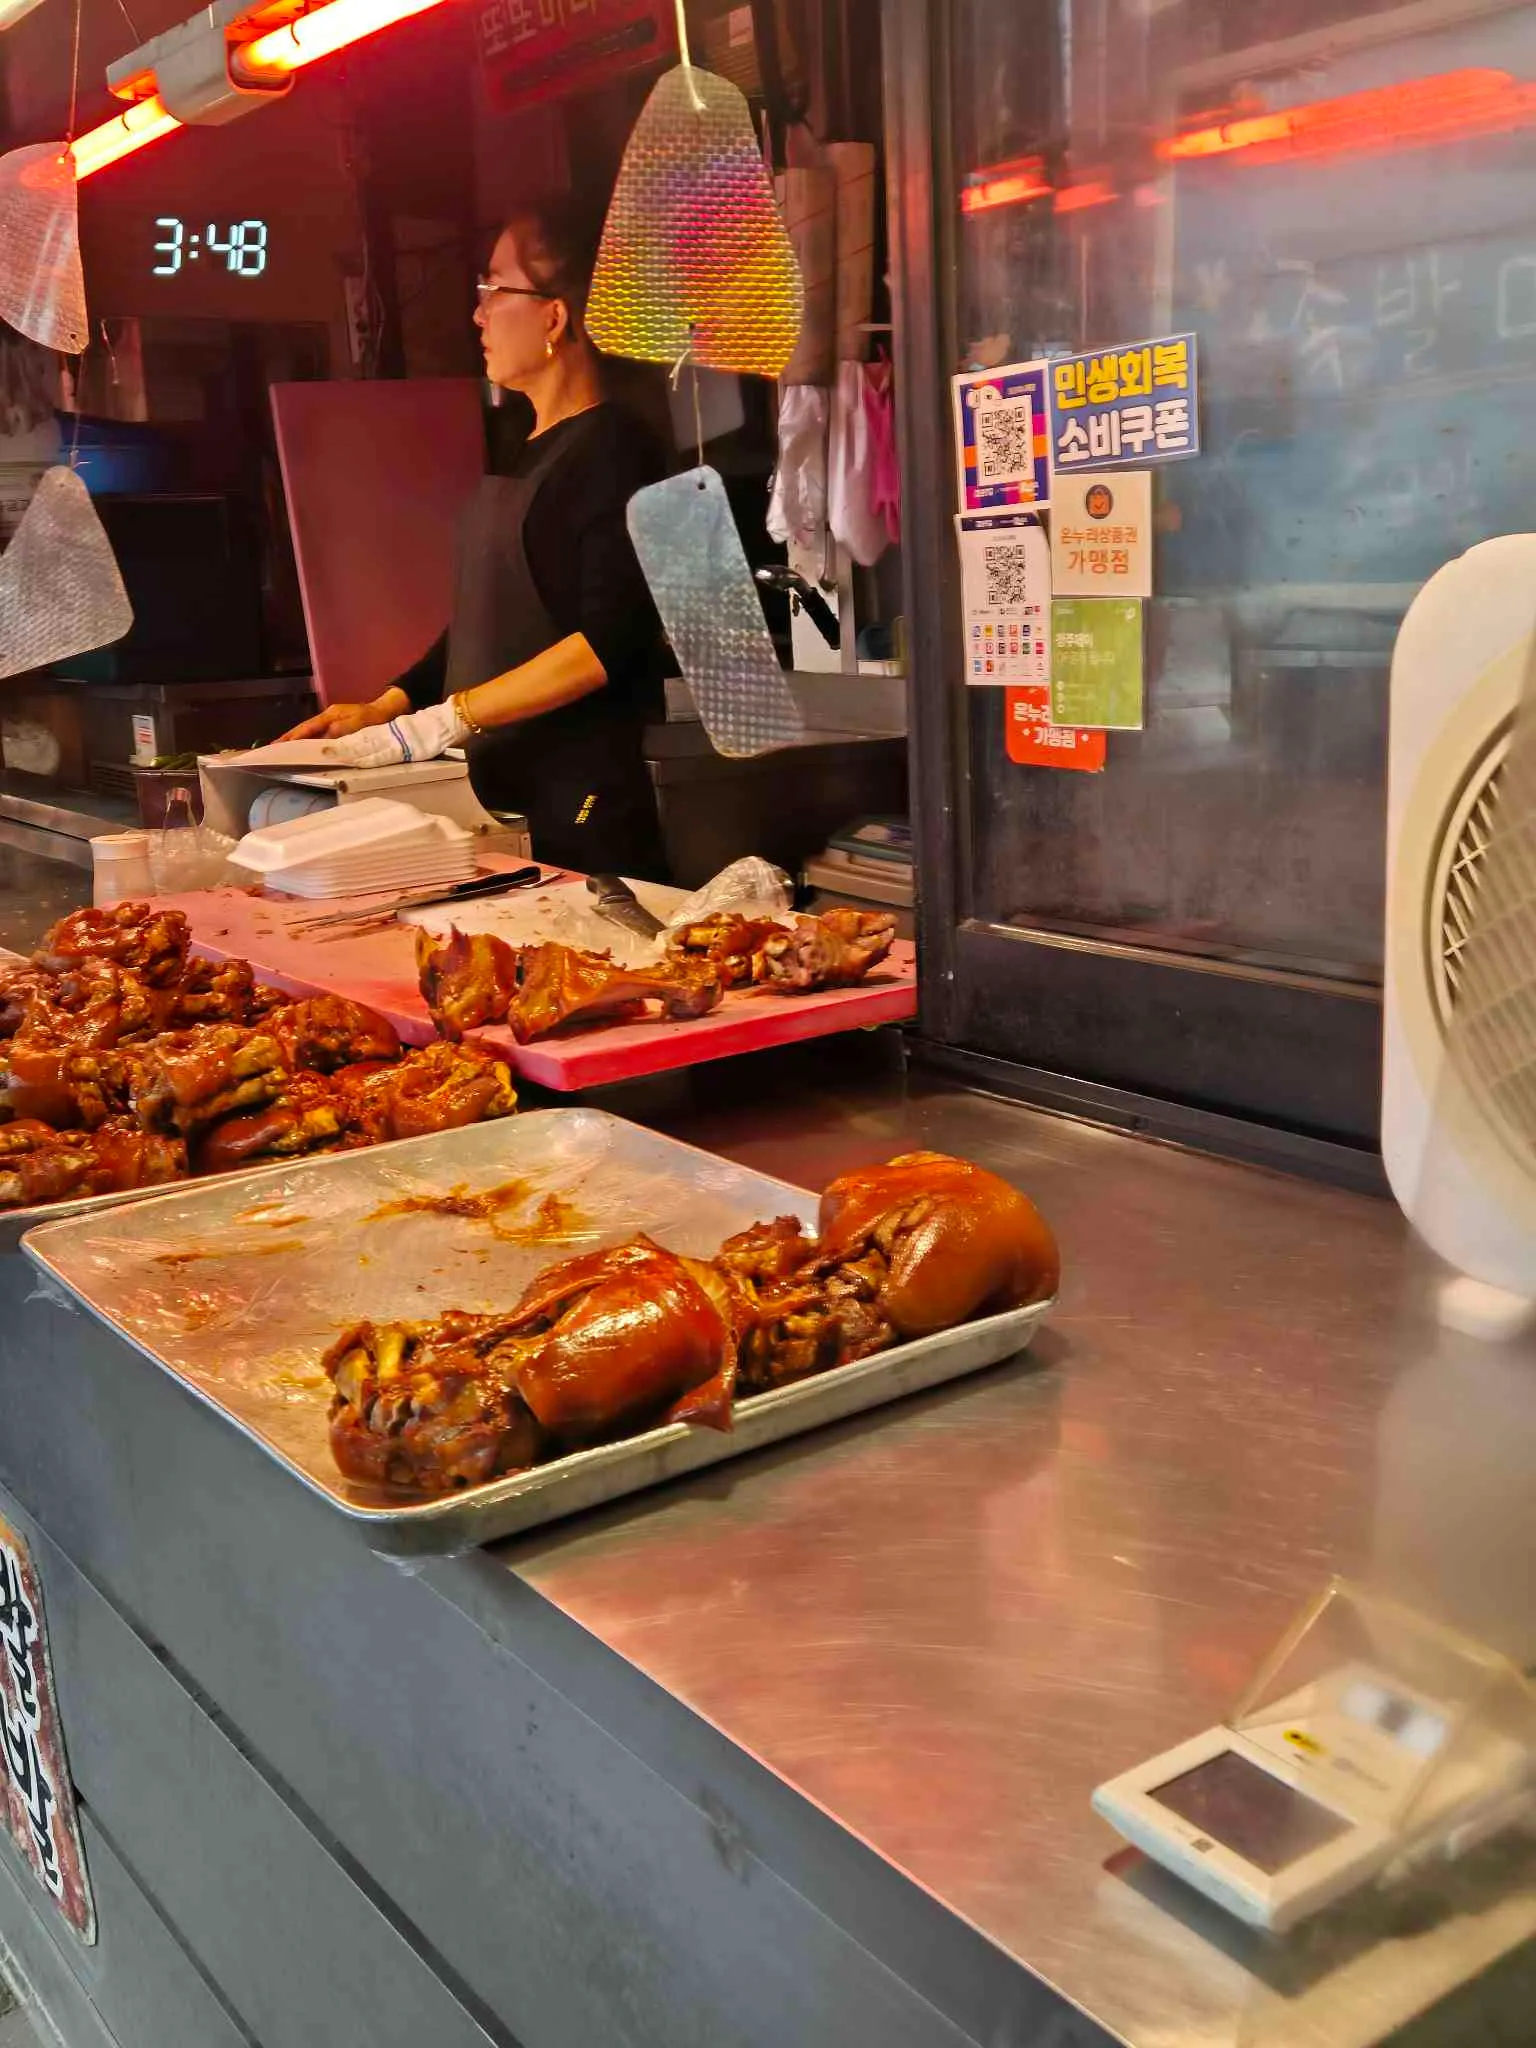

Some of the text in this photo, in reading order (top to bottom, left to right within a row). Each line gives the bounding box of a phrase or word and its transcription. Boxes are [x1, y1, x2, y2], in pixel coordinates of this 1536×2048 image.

[152, 218, 268, 275] 3:48
[1055, 340, 1188, 410] 민생회복
[1057, 398, 1189, 463] 소비쿠폰
[1060, 527, 1137, 544] 온누리상품권
[1068, 549, 1129, 575] 가맹점
